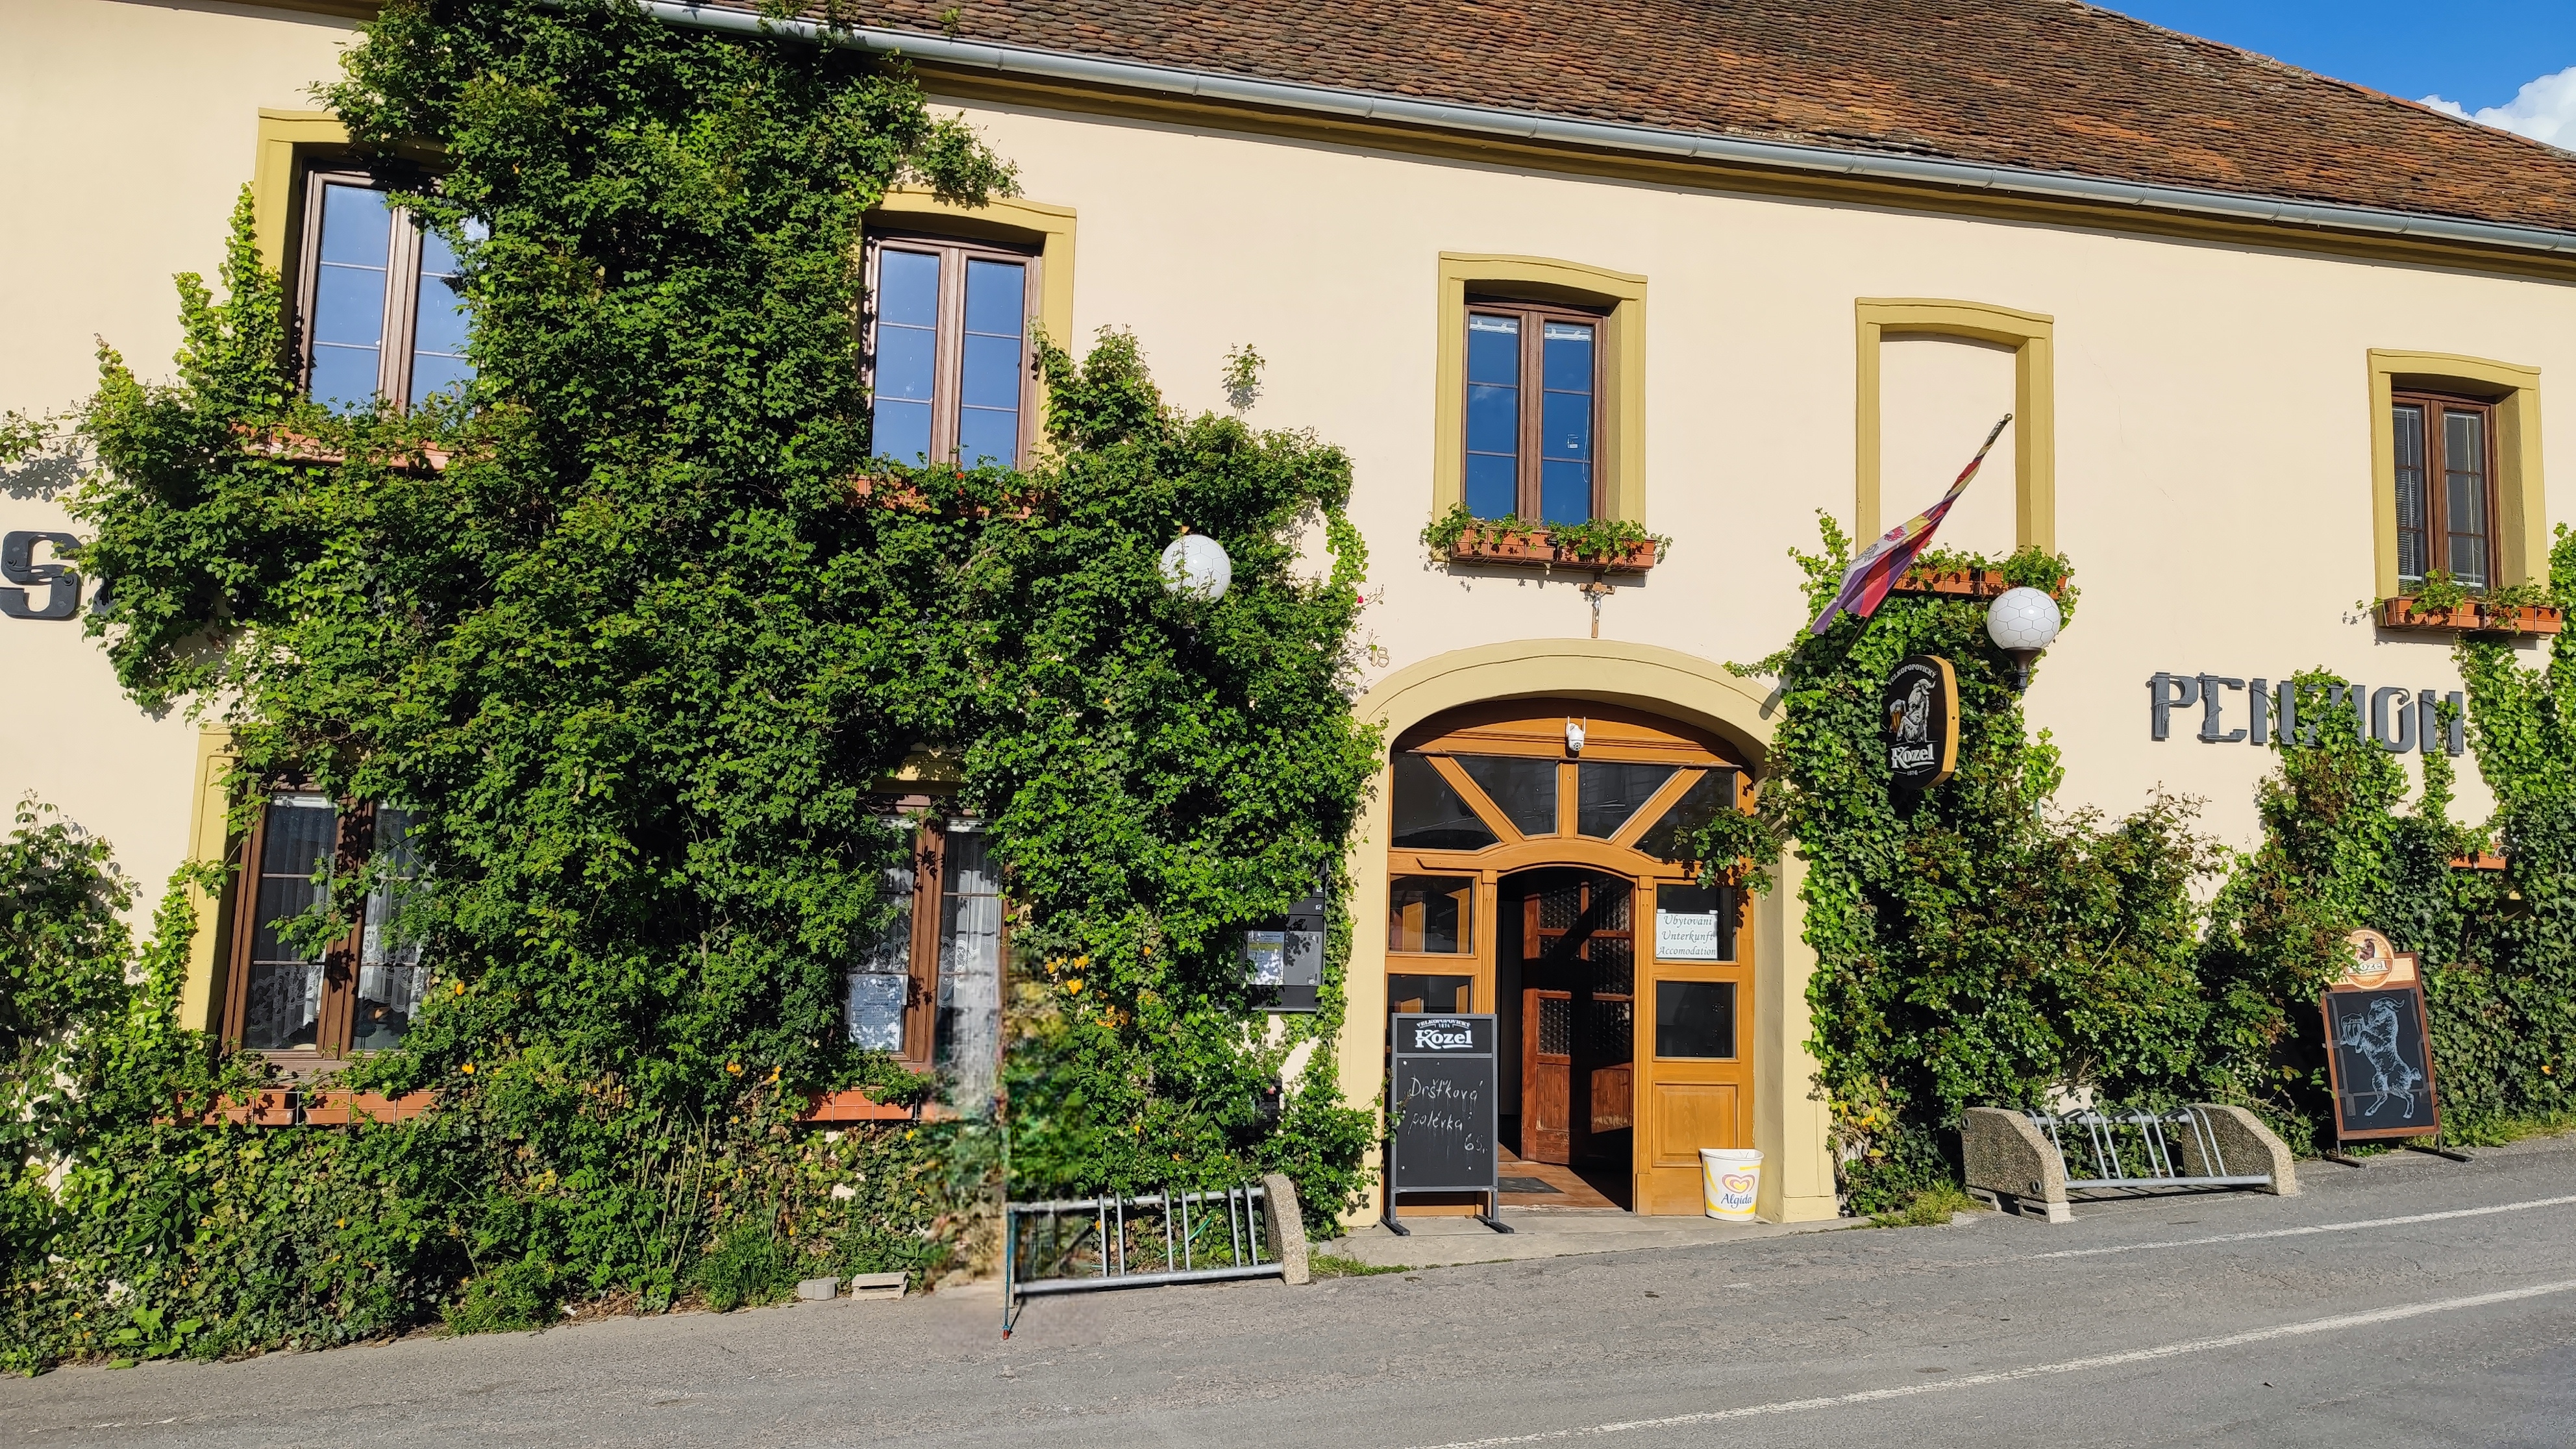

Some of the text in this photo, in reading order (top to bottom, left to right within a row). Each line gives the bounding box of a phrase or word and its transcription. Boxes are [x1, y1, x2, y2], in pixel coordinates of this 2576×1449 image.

[1890, 743, 1935, 769] Kozel
[1663, 914, 1713, 928] Ubytování
[1661, 930, 1715, 944] Unterkunft
[1657, 945, 1716, 956] Accomodation
[1415, 1030, 1473, 1049] Kozel
[1721, 1193, 1752, 1209] Algida
